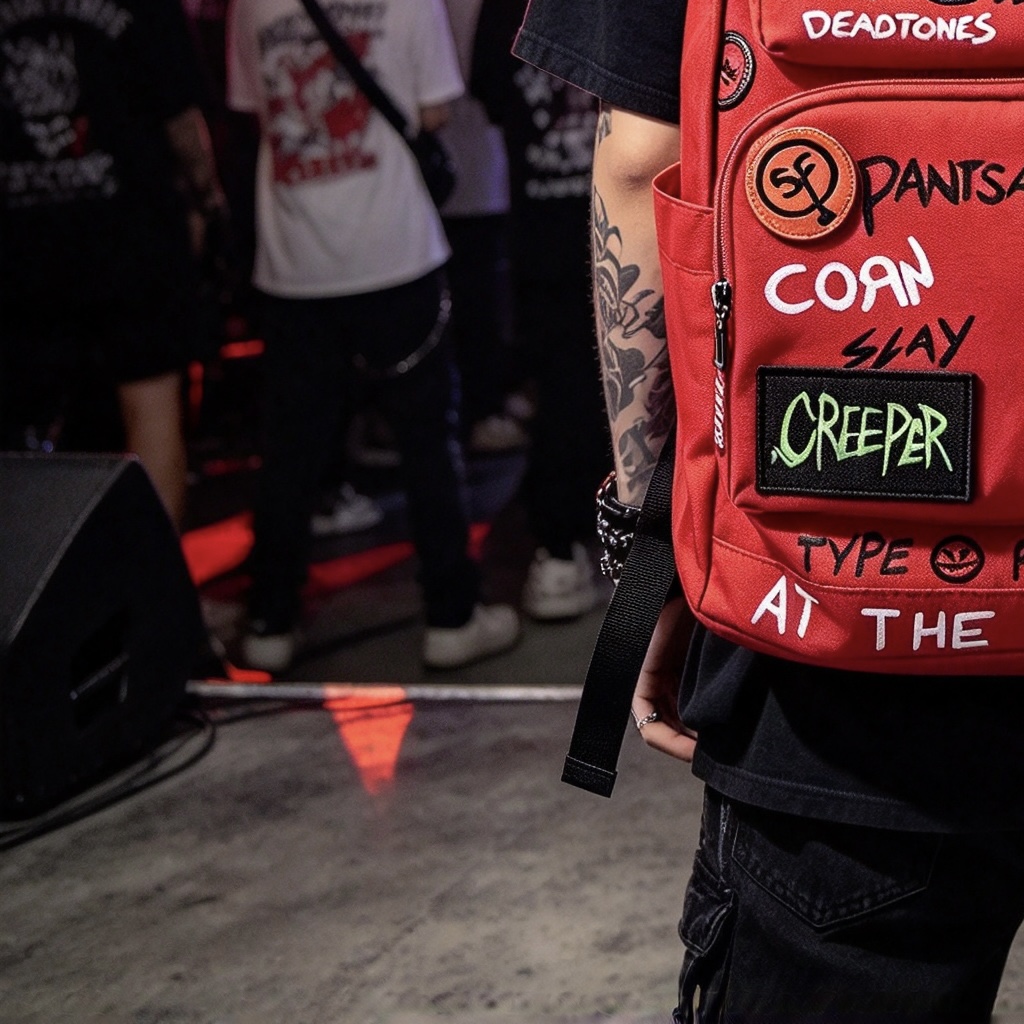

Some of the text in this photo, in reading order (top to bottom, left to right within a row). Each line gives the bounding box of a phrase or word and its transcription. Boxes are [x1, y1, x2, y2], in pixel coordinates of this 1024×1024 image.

[802, 10, 996, 45] DEADTONES
[771, 391, 953, 477] CREEPER
[798, 531, 914, 578] TYPE
[751, 575, 819, 639] AT
[861, 607, 996, 652] THE
